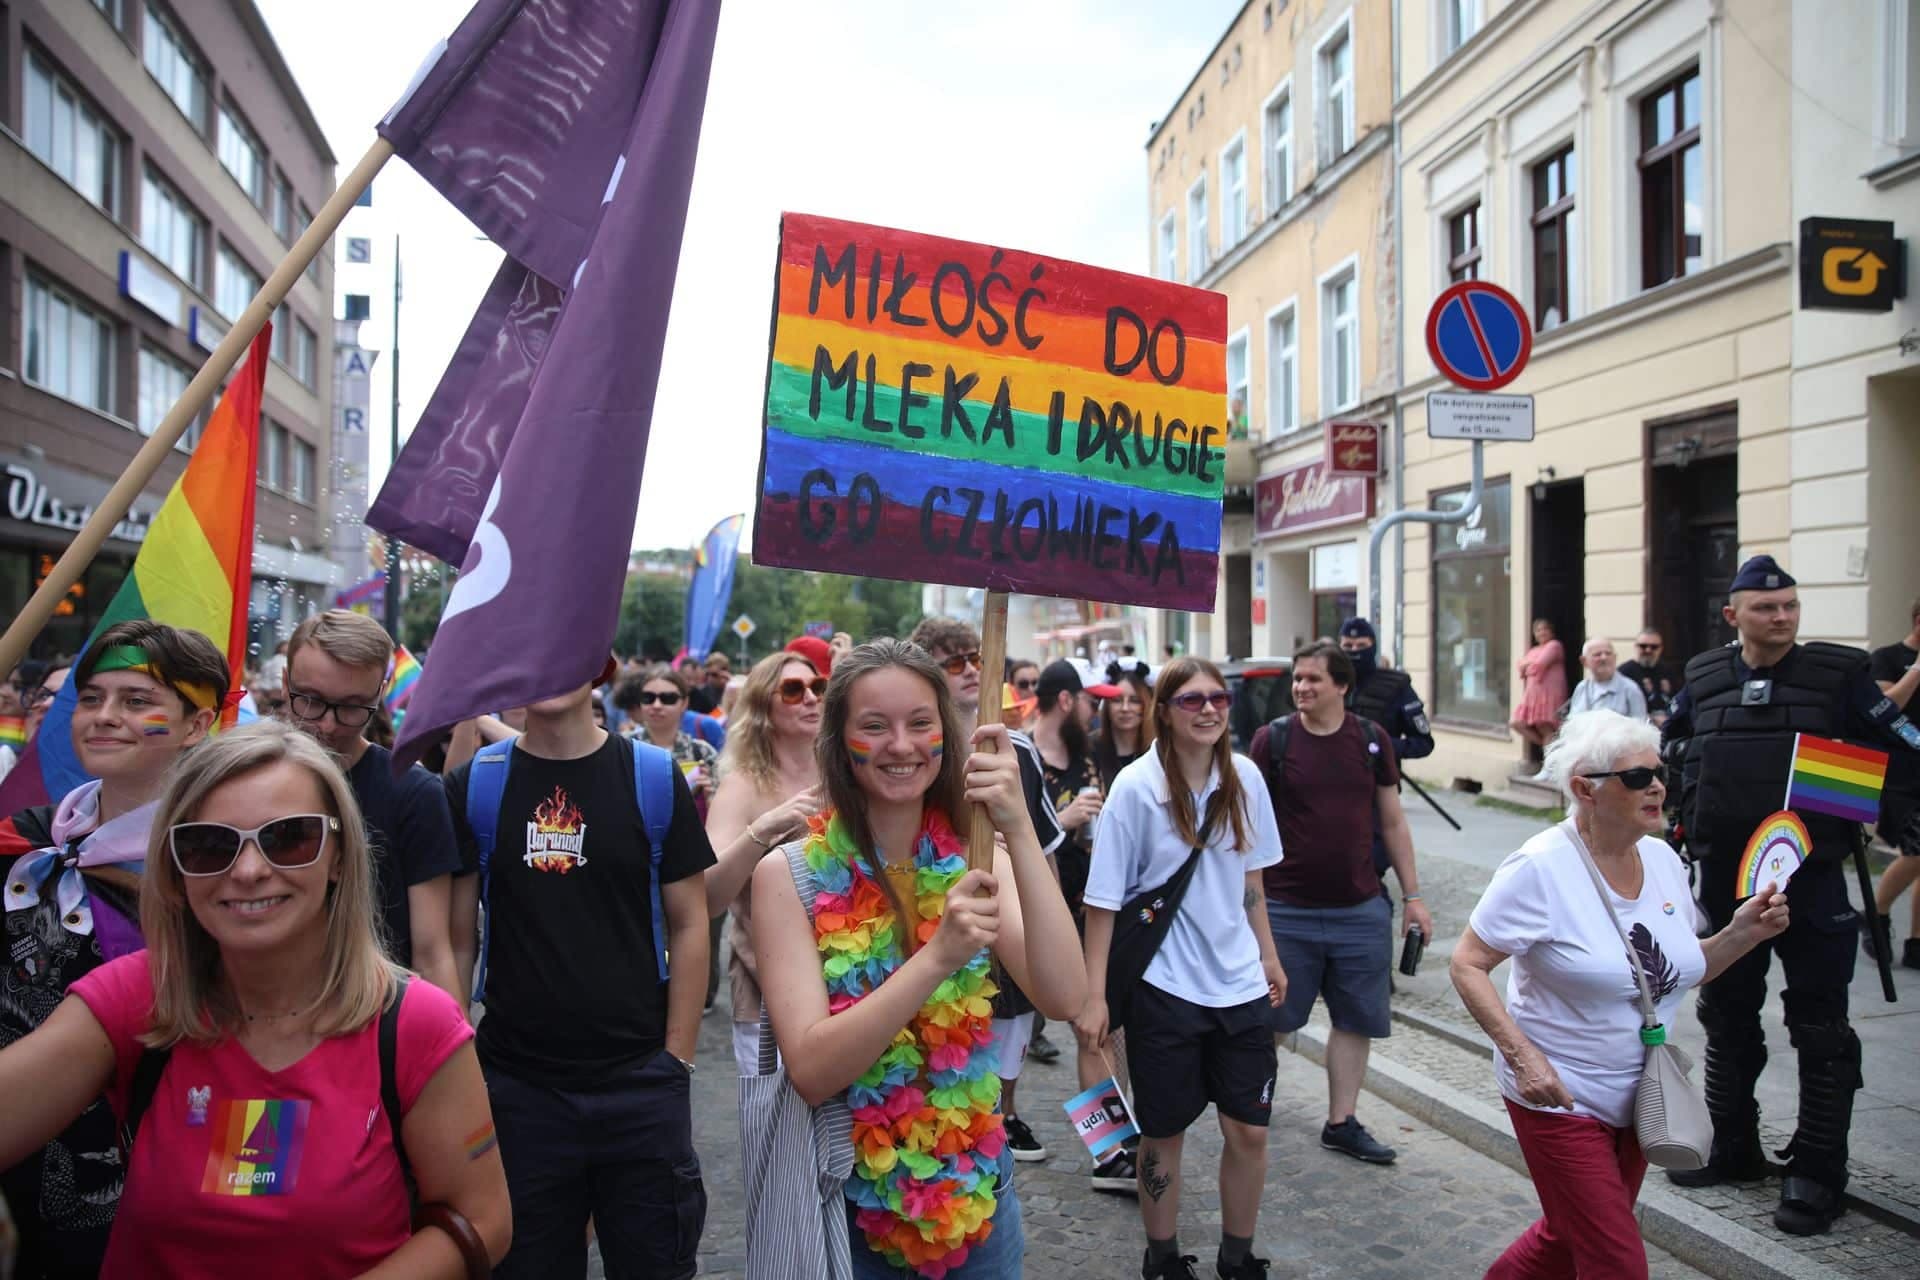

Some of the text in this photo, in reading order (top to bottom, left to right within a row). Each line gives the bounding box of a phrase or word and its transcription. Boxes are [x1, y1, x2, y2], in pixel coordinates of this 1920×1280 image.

[808, 243, 1186, 386] MIŁOŚĆ DO
[809, 344, 1015, 448] MLEKA
[1046, 391, 1065, 456] I
[921, 485, 1186, 587] CZŁOWIEKA
[227, 1170, 276, 1185] razem
